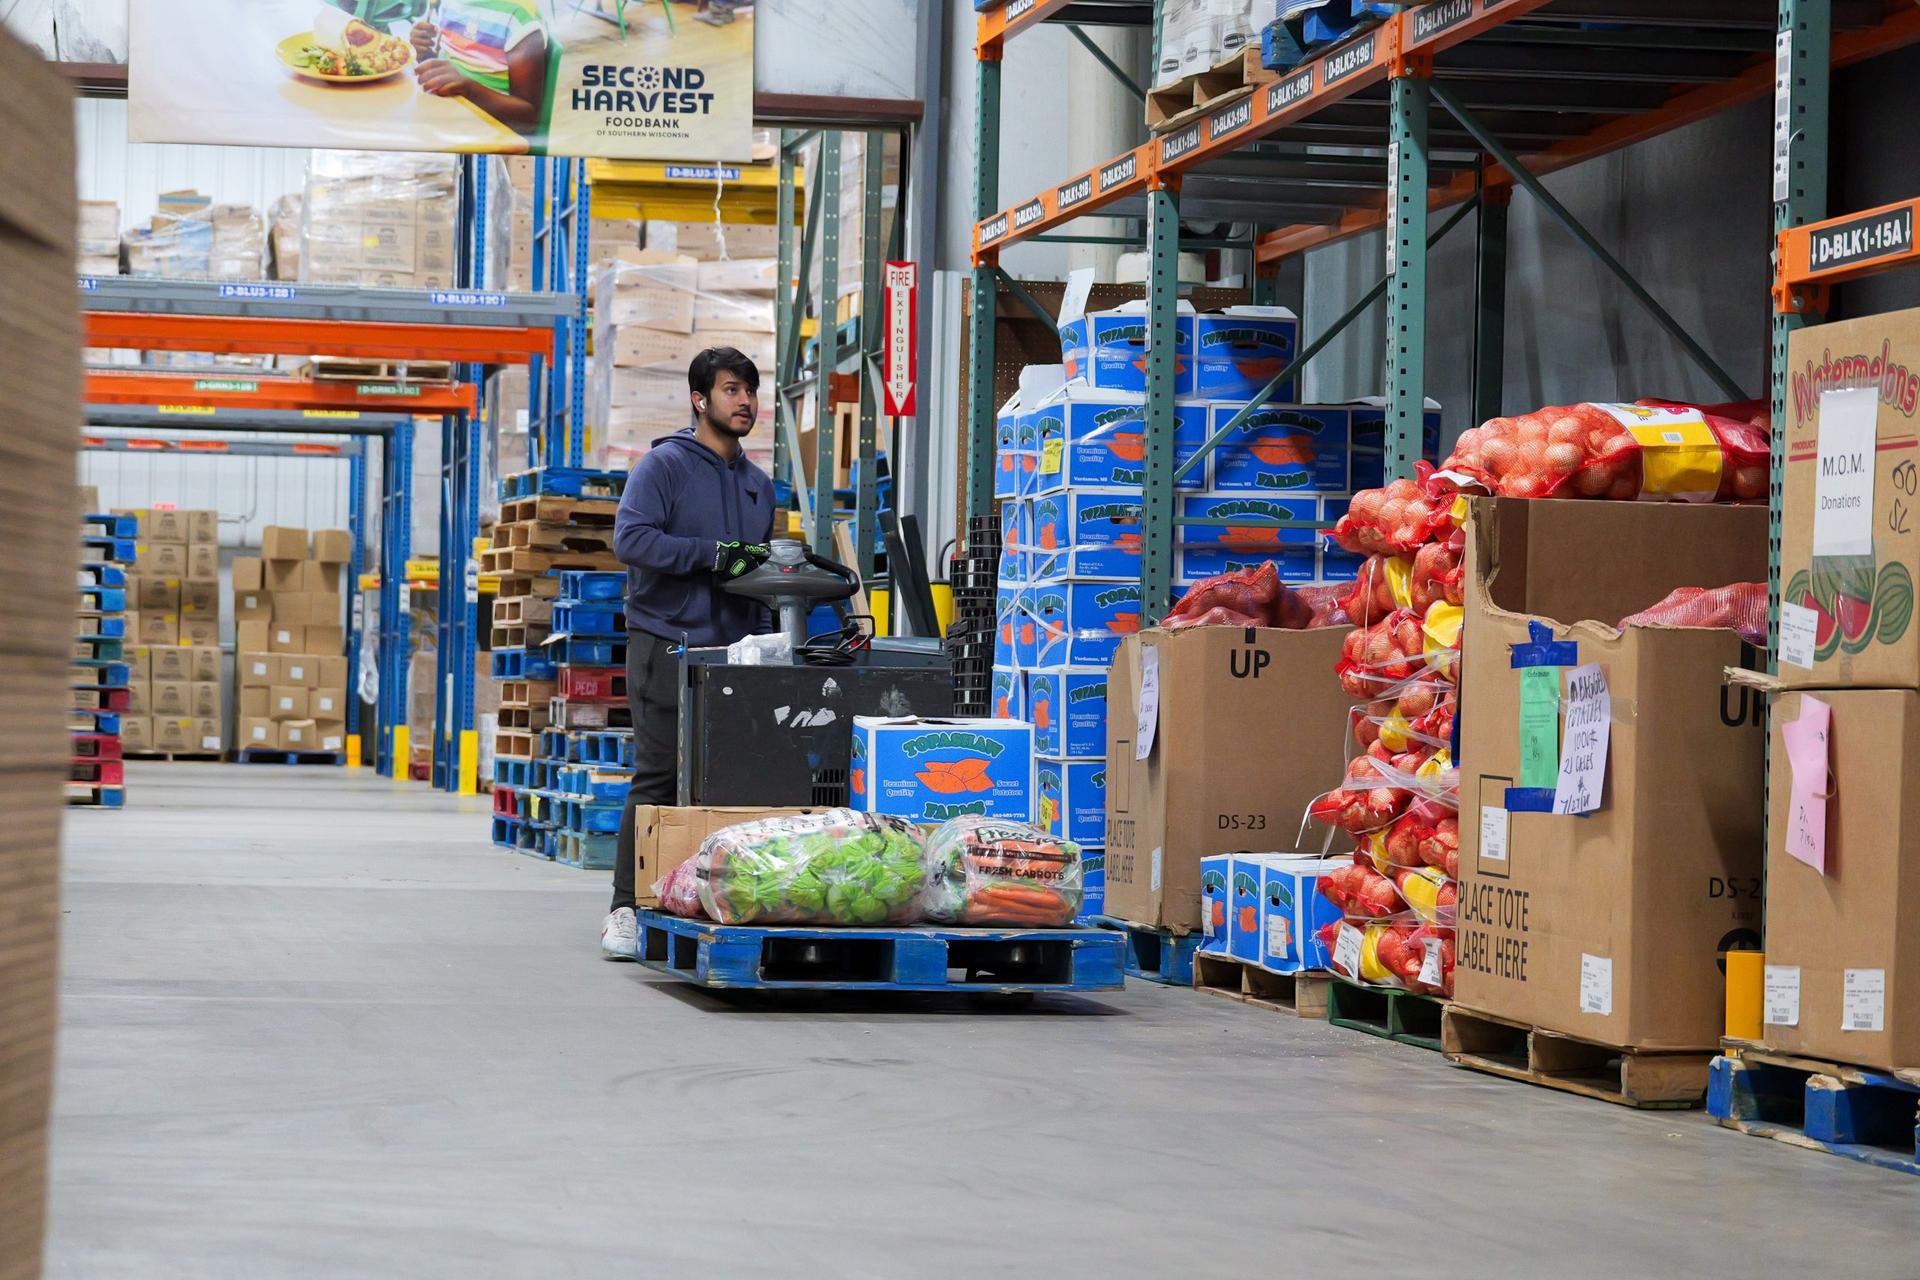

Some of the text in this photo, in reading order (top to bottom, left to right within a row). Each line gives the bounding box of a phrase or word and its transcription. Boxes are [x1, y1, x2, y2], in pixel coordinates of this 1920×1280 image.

[1418, 1, 1467, 35] D-BLK1-17A
[1328, 40, 1370, 80] D-BLK2-19B
[582, 64, 705, 90] SECOND
[572, 88, 714, 114] HARVEST
[1271, 77, 1310, 108] D-BLK1-19B
[605, 116, 680, 128] FOODBANK
[1213, 103, 1248, 135] D-BLK2-19A
[1165, 127, 1198, 160] D-BLK1-19A
[1819, 218, 1903, 263] D-BLK1-15A
[890, 271, 910, 287] FIRE
[896, 290, 905, 399] EXTINGUISHER
[1791, 440, 1816, 451] PRODUCT
[1822, 453, 1865, 477] M.O.M.
[1255, 471, 1311, 490] FARMS
[1821, 492, 1861, 510] Donations
[1230, 648, 1271, 679] UP
[902, 731, 1006, 759] TOPASHAW
[883, 779, 918, 788] Premium
[886, 788, 915, 797] Quality
[993, 788, 1023, 796] Potatoes
[997, 779, 1019, 787] Sweet
[923, 800, 986, 820] FARMS
[1218, 815, 1266, 830] DS-23
[1015, 868, 1065, 880] CARROTS
[1708, 877, 1761, 899] DS-2
[1457, 880, 1529, 932] PLACE TOTE
[1456, 927, 1492, 973] LABEL
[1495, 935, 1529, 982] HERE
